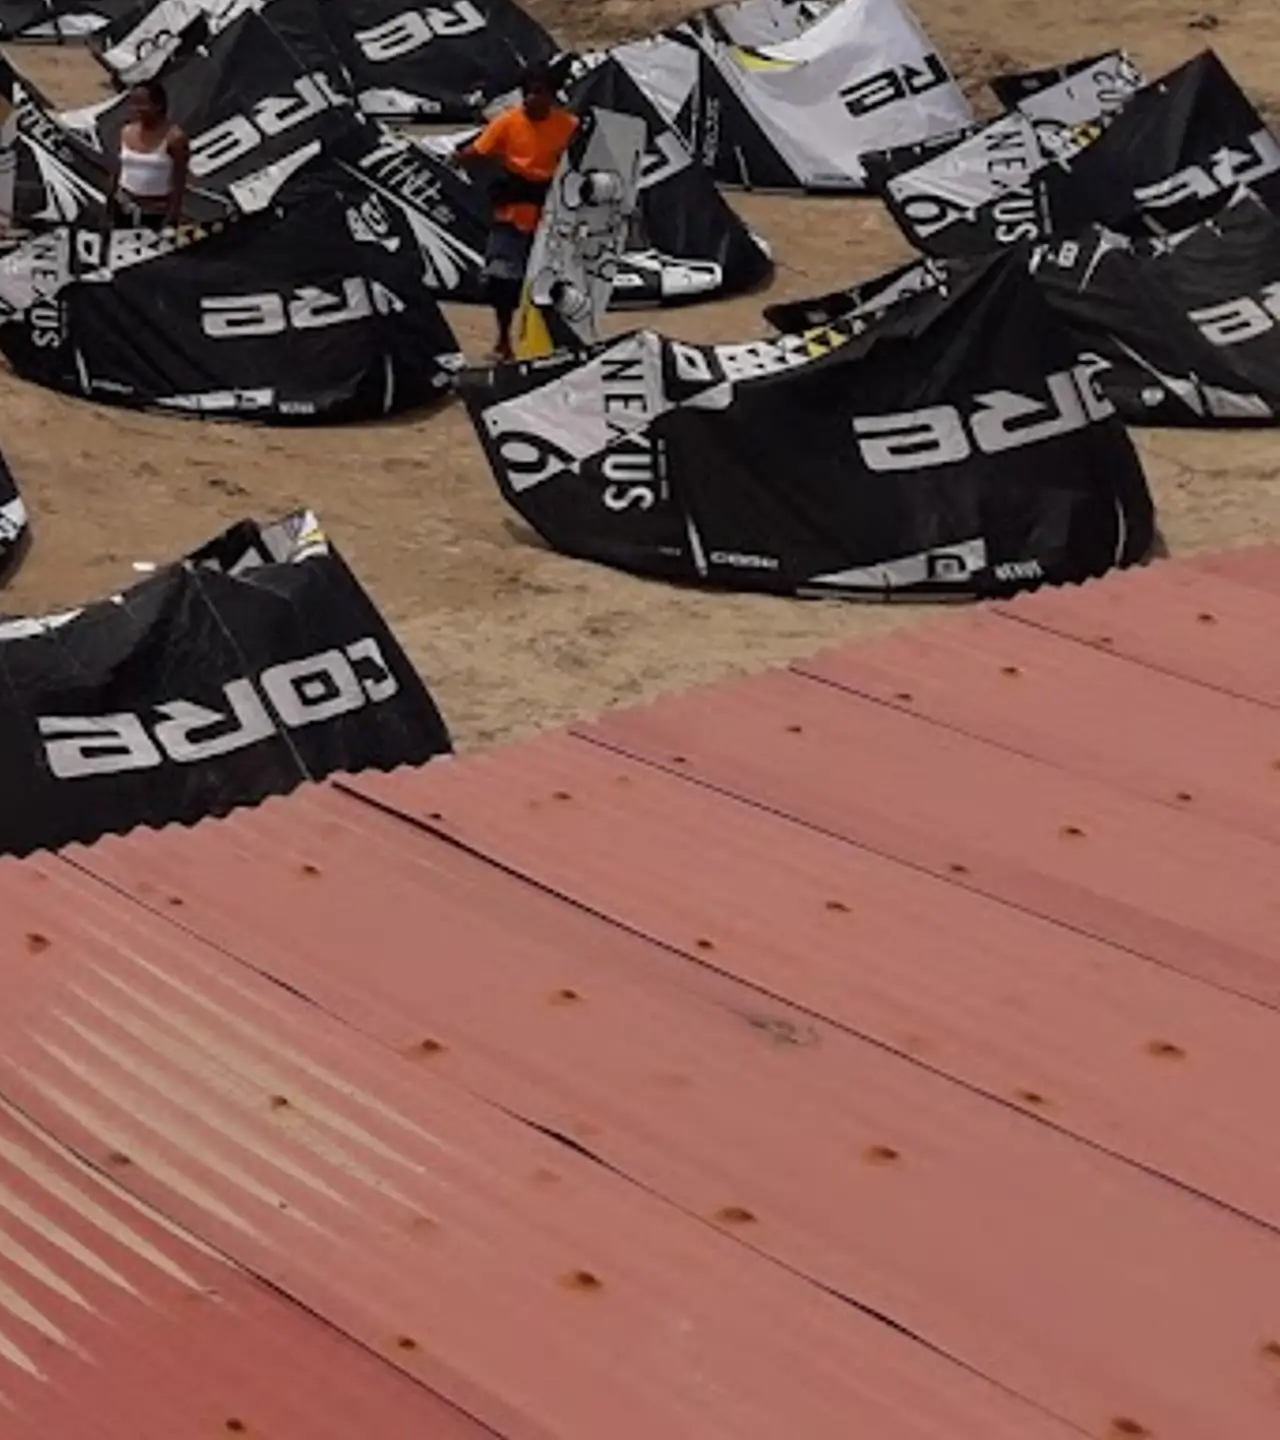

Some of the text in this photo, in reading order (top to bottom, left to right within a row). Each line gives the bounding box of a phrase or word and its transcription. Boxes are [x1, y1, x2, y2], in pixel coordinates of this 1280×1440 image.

[985, 128, 1039, 243] NEXUS
[30, 237, 61, 348] NEXUS
[600, 359, 656, 512] NEXUS
[36, 636, 399, 779] CORE
